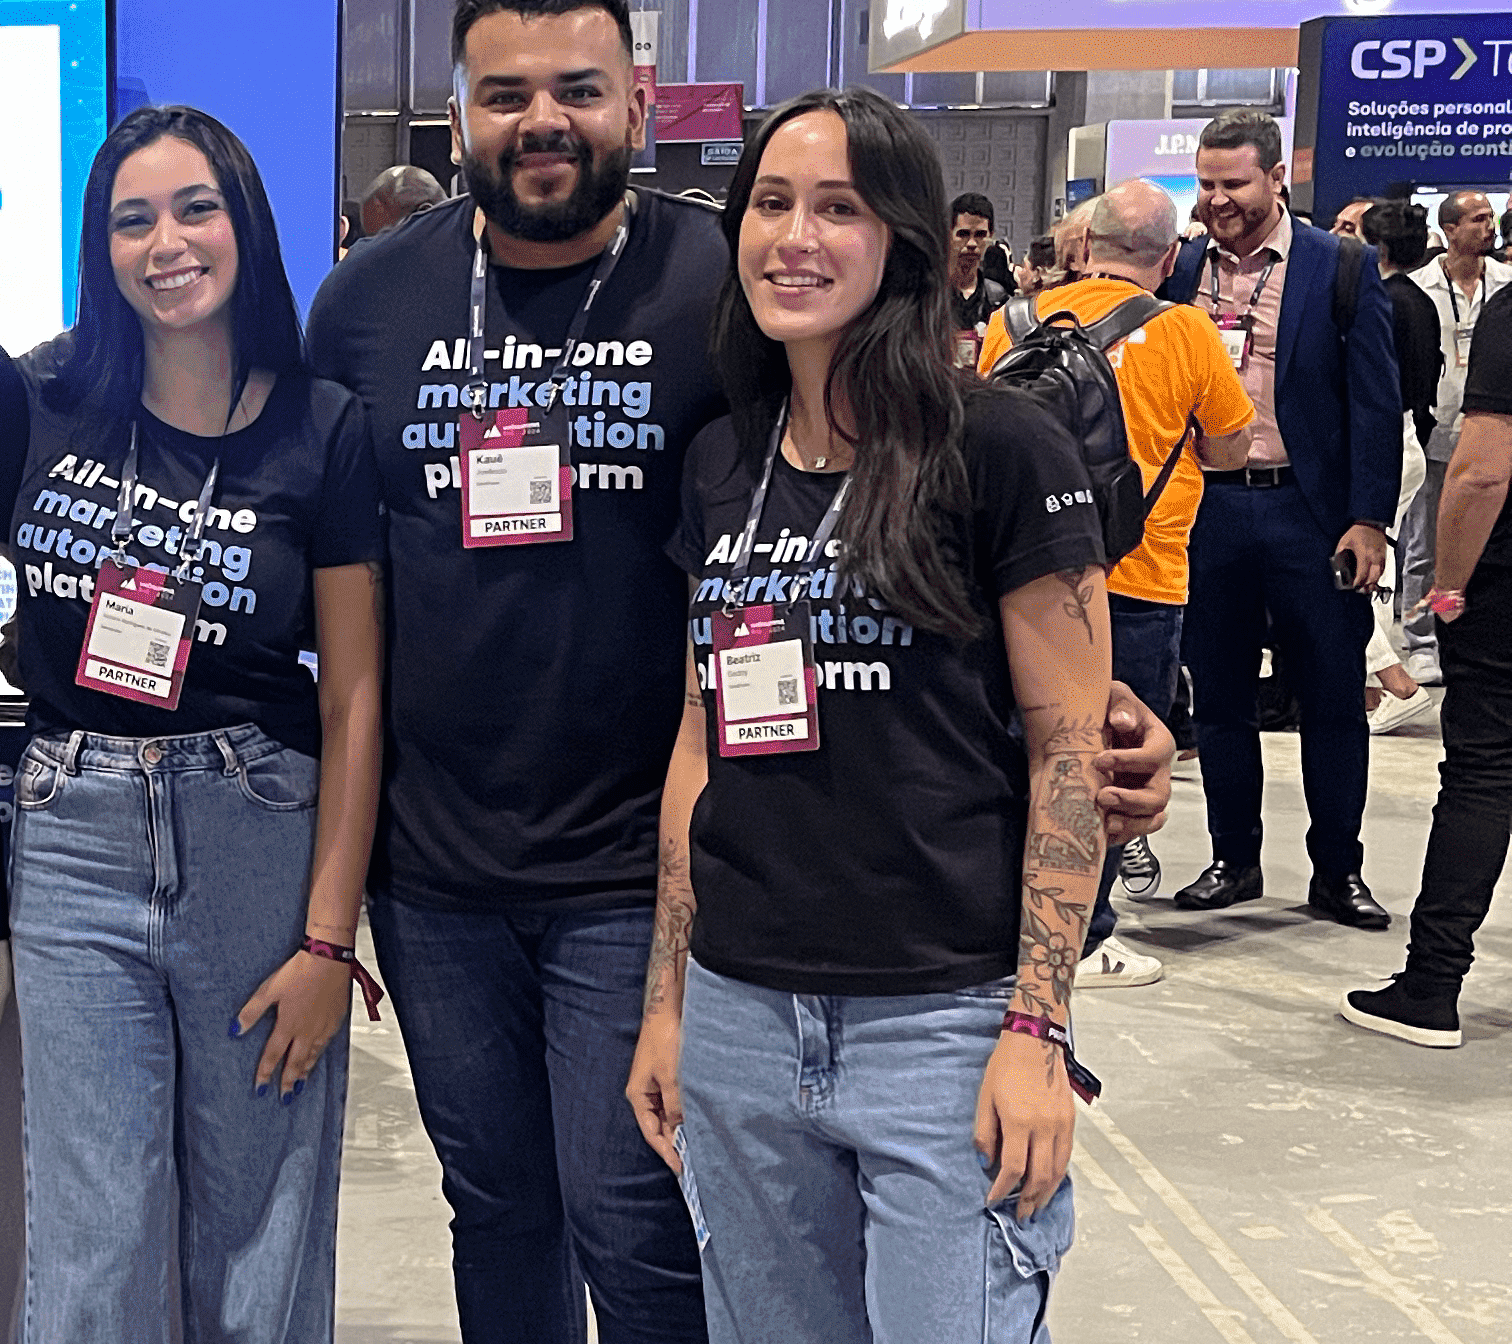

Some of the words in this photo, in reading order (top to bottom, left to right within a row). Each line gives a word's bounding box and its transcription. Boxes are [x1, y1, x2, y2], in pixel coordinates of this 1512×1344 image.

[1351, 39, 1446, 79] CSP
[1347, 100, 1429, 119] Soluções
[1346, 121, 1451, 139] inteligência
[1456, 121, 1479, 136] de
[1345, 147, 1356, 158] e
[1360, 141, 1455, 161] evolução
[484, 518, 547, 533] PARTNER
[98, 666, 157, 691] PARTNER
[738, 723, 795, 739] PARTNER
